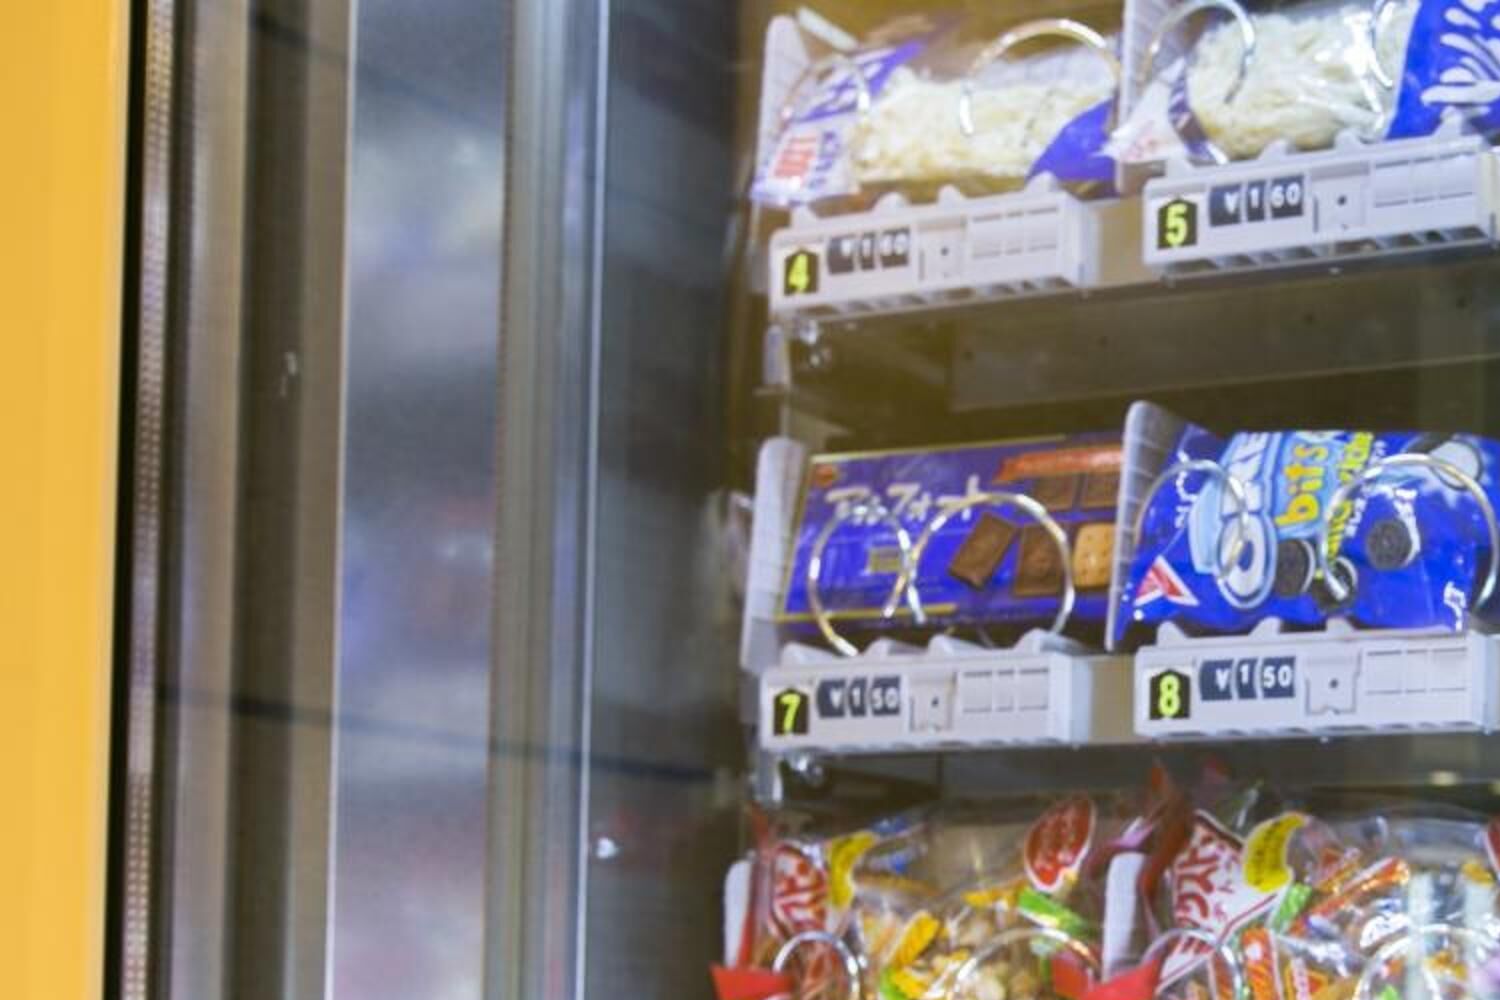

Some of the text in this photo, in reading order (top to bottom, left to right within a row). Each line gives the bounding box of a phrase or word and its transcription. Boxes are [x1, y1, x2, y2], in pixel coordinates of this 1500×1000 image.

[1164, 204, 1188, 247] 5
[788, 252, 810, 291] 4
[780, 692, 801, 734] 7
[1158, 673, 1181, 718] 8
